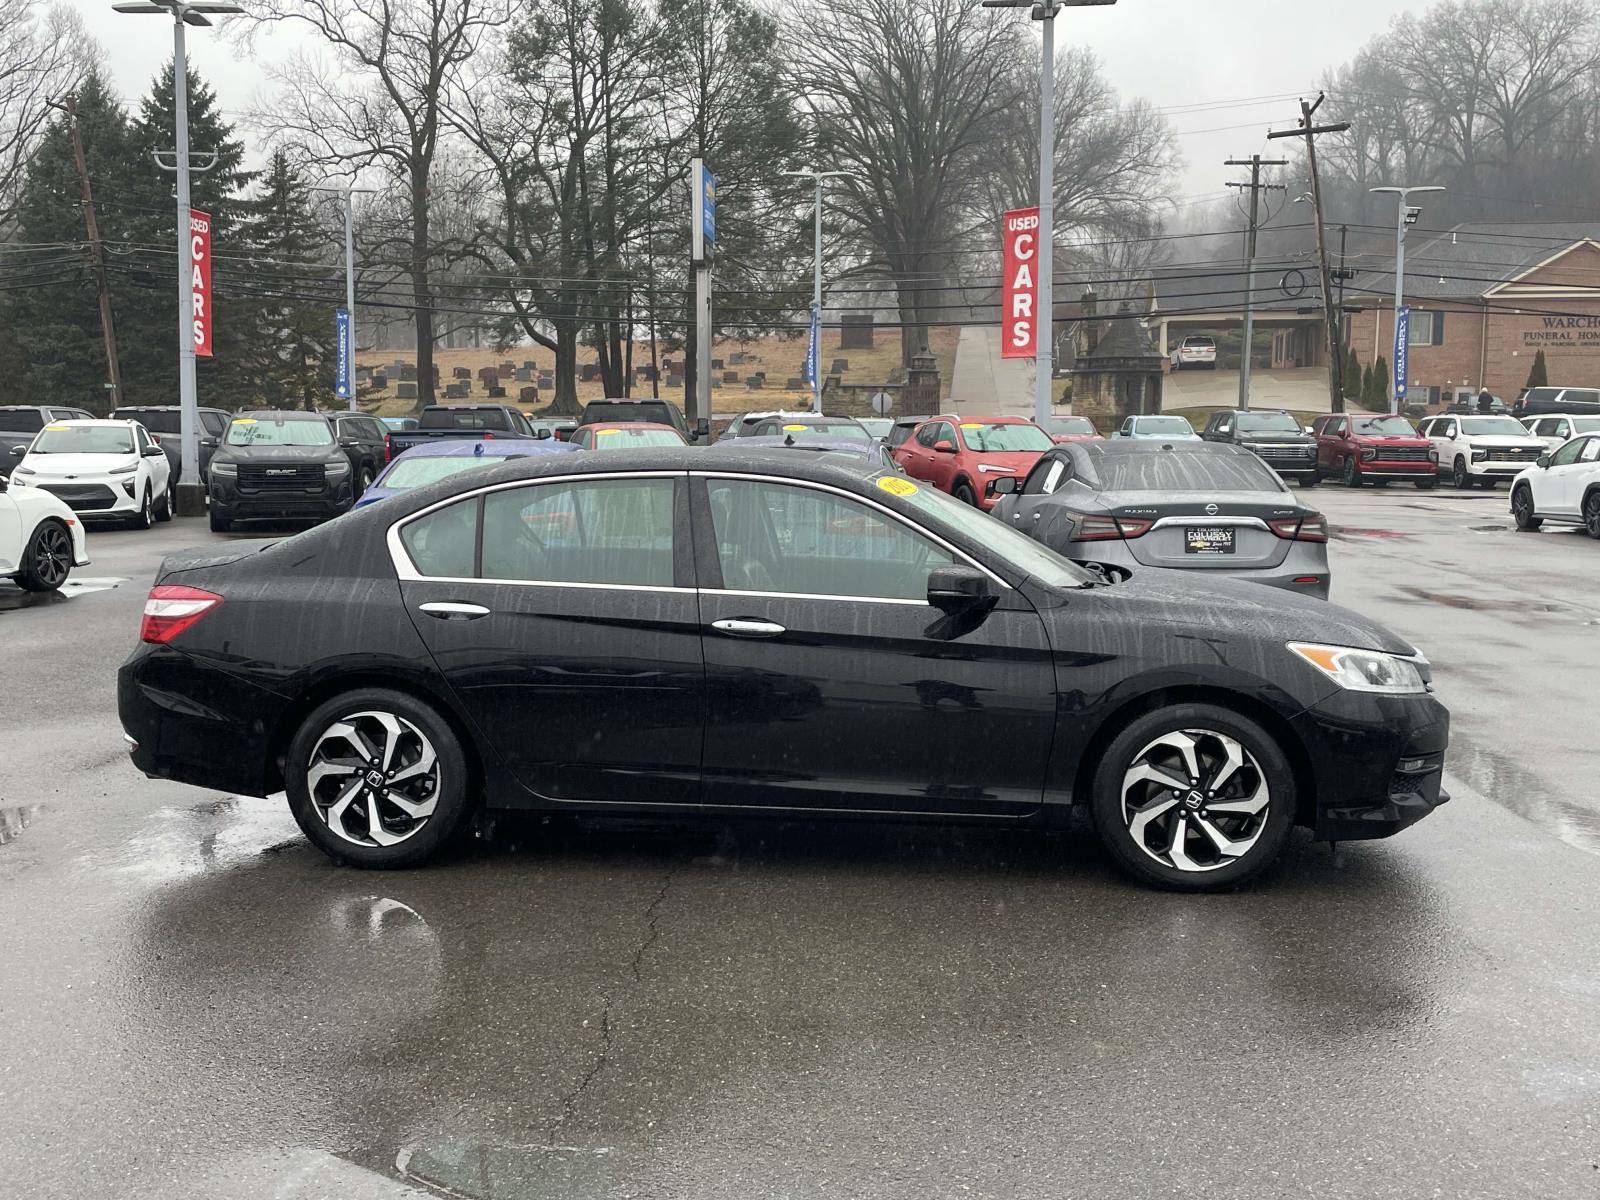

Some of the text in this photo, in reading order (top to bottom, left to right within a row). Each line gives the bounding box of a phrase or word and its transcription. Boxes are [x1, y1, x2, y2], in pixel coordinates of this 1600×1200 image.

[1008, 215, 1039, 231] USED
[191, 235, 205, 345] CARS
[1012, 233, 1034, 347] CARS
[1543, 317, 1600, 329] WARCH
[1523, 332, 1573, 340] FUNERAL
